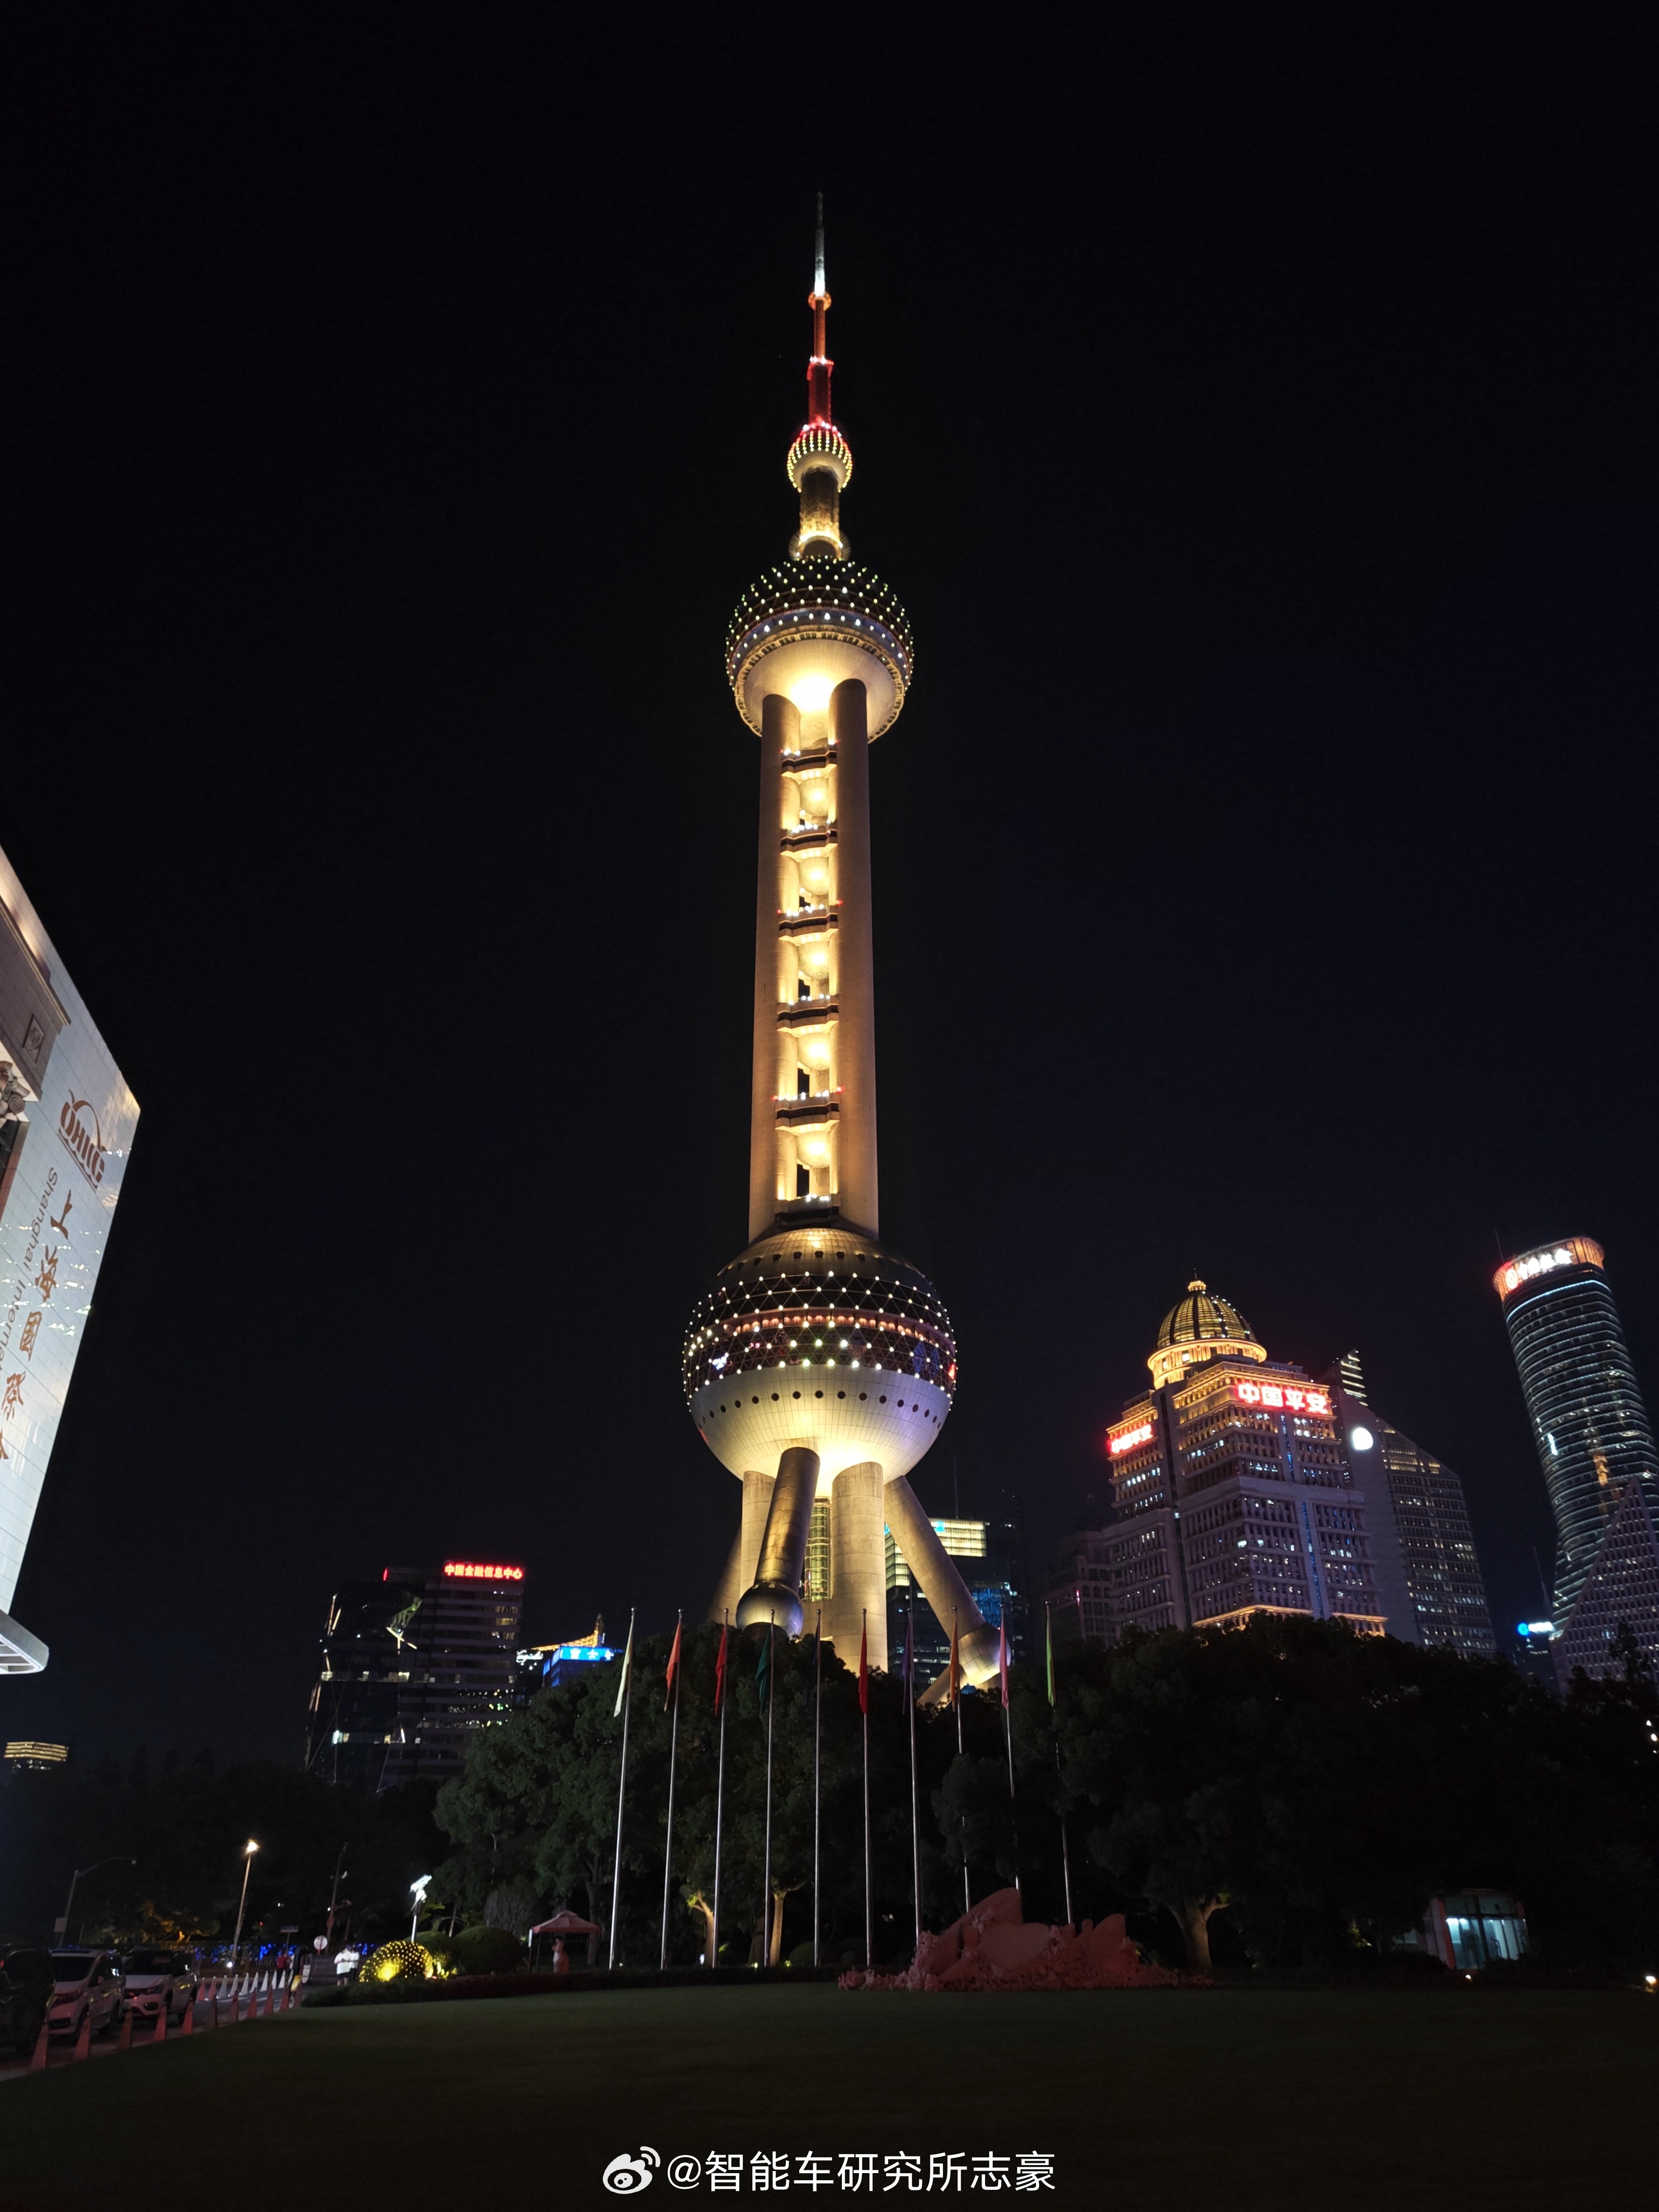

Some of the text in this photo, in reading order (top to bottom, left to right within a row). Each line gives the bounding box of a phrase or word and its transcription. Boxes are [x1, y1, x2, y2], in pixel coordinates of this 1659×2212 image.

[0, 1167, 58, 1371] Shanghai Interna
[1238, 1383, 1328, 1414] 中国平安
[444, 1564, 523, 1580] 中国金融信息中心
